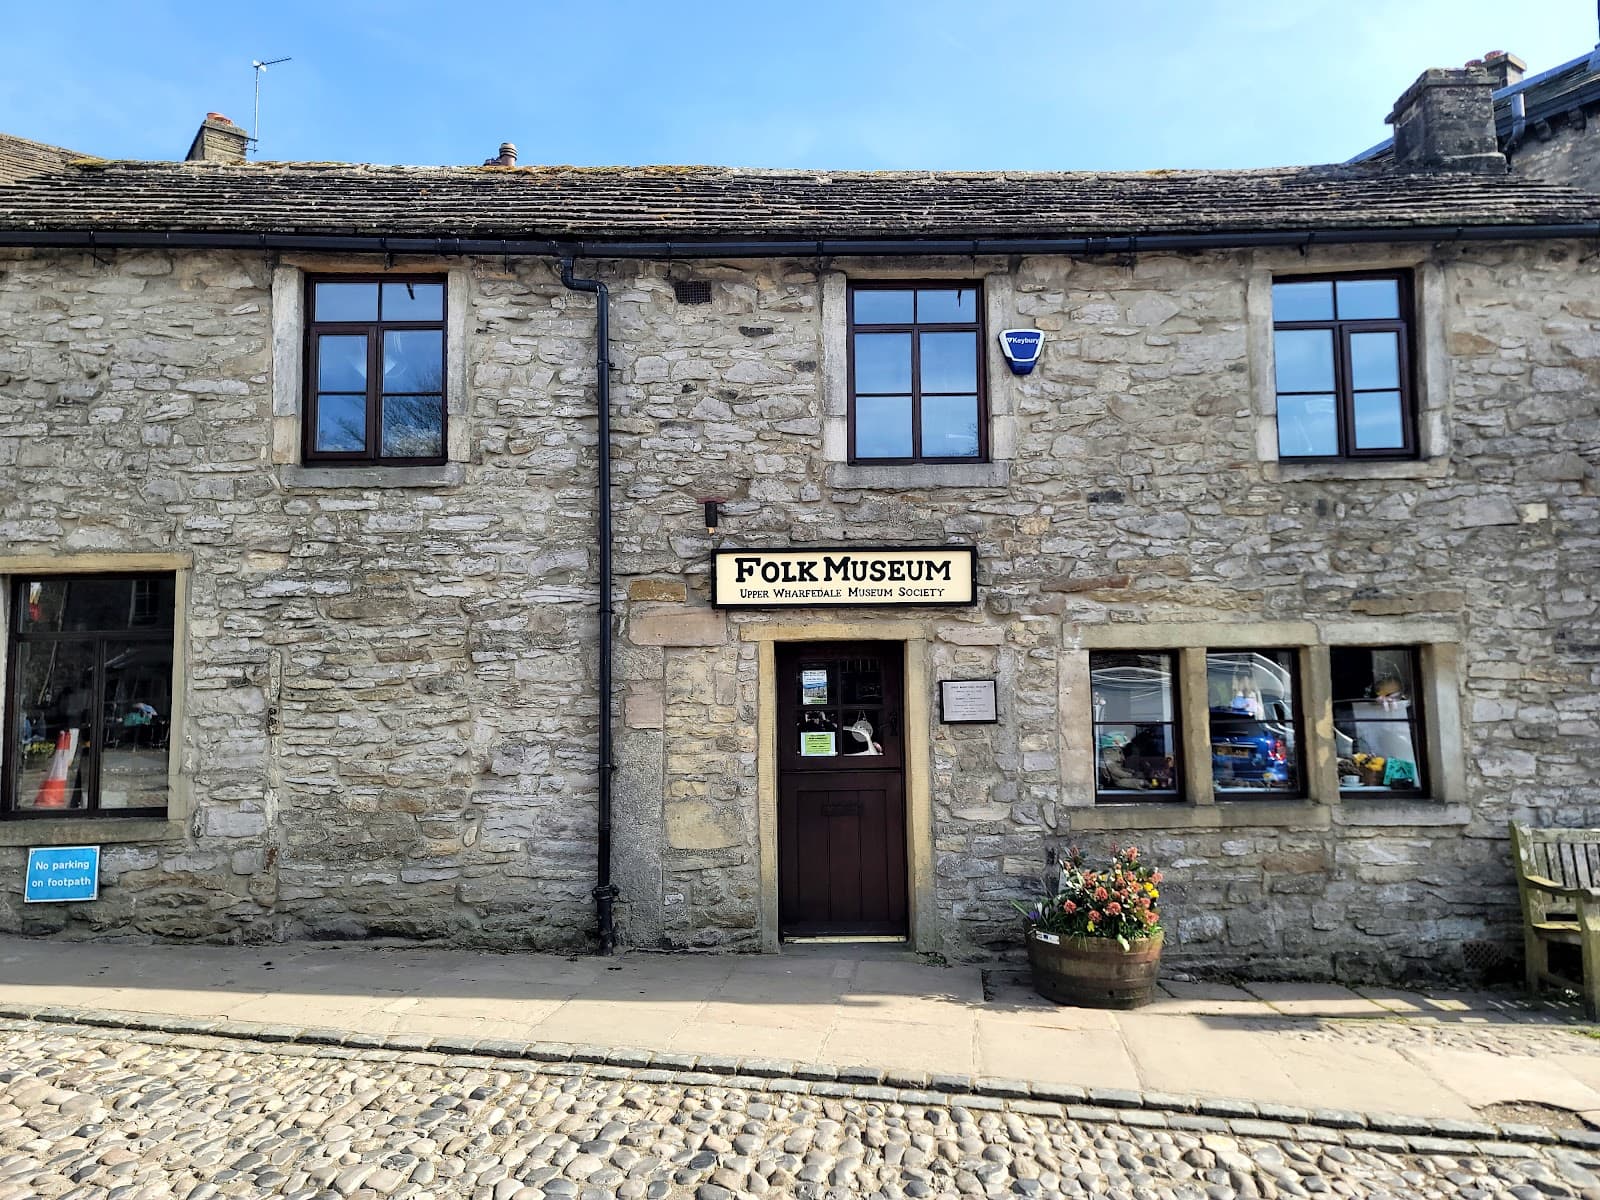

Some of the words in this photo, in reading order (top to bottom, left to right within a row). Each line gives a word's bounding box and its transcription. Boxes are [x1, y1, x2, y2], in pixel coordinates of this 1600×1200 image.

[735, 558, 818, 583] FOLK
[824, 556, 951, 582] MUSEUM
[740, 589, 769, 598] UPPER
[773, 588, 842, 598] WHARFEDALE
[848, 587, 893, 597] MUSEUM
[898, 587, 945, 597] SOCIETY
[35, 861, 49, 870] No
[52, 860, 90, 871] parking
[47, 877, 91, 888] footpath
